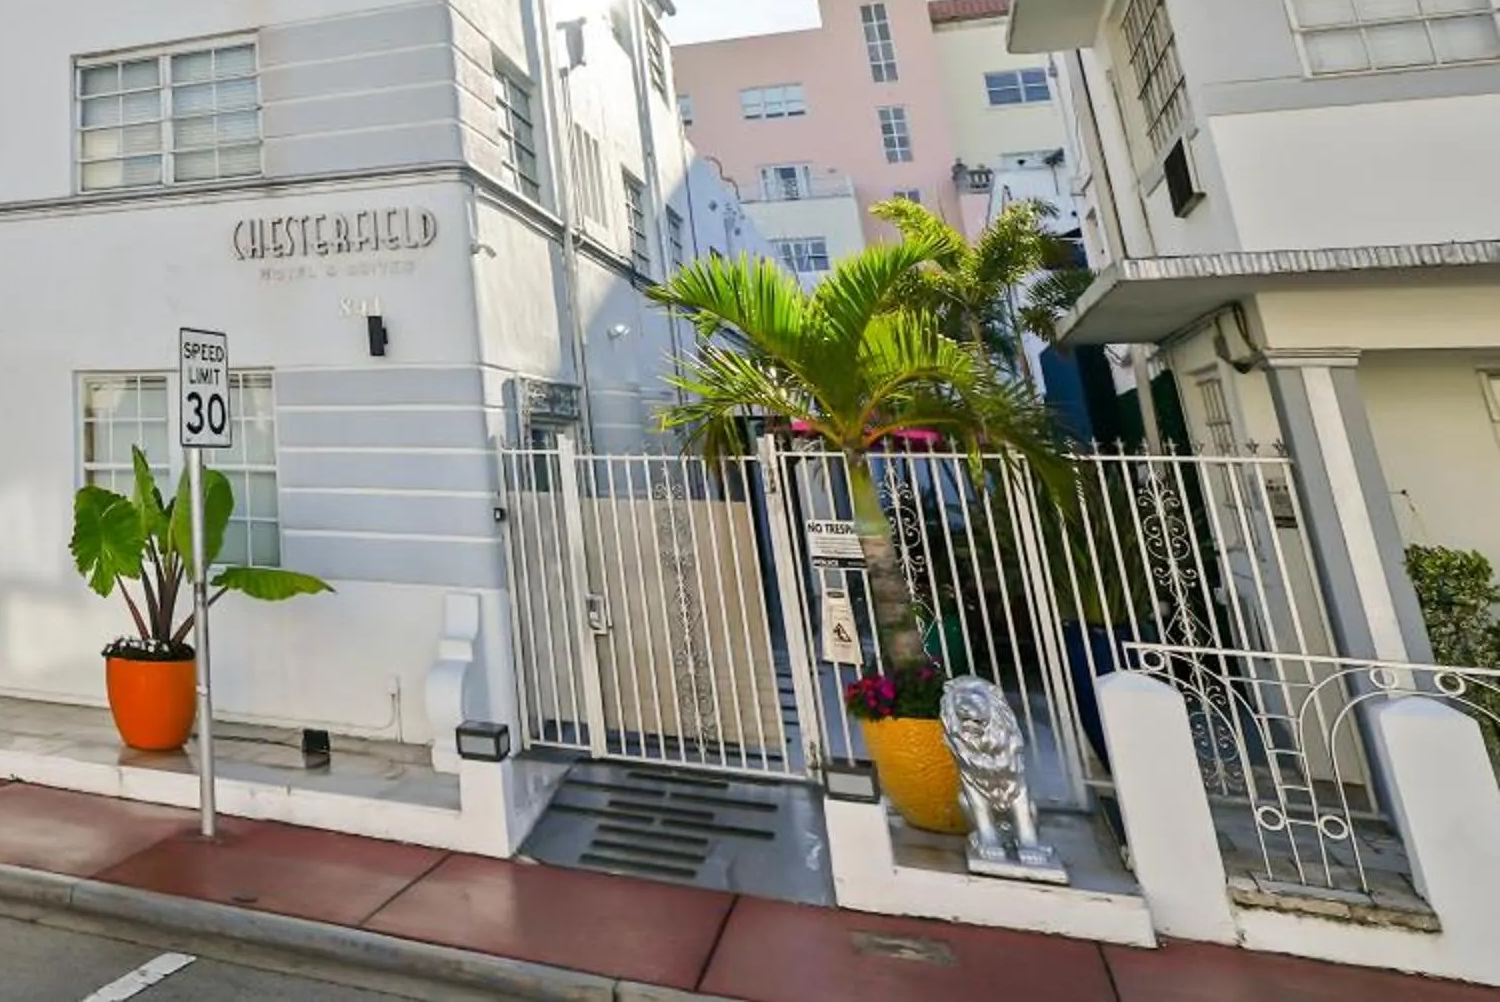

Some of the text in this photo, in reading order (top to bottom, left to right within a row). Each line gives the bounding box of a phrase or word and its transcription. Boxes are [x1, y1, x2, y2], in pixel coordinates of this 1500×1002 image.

[234, 207, 437, 261] CHESTERFIELD
[183, 341, 225, 363] SPEED
[188, 367, 221, 385] LIMIT
[186, 392, 226, 435] 30
[808, 523, 823, 533] NO
